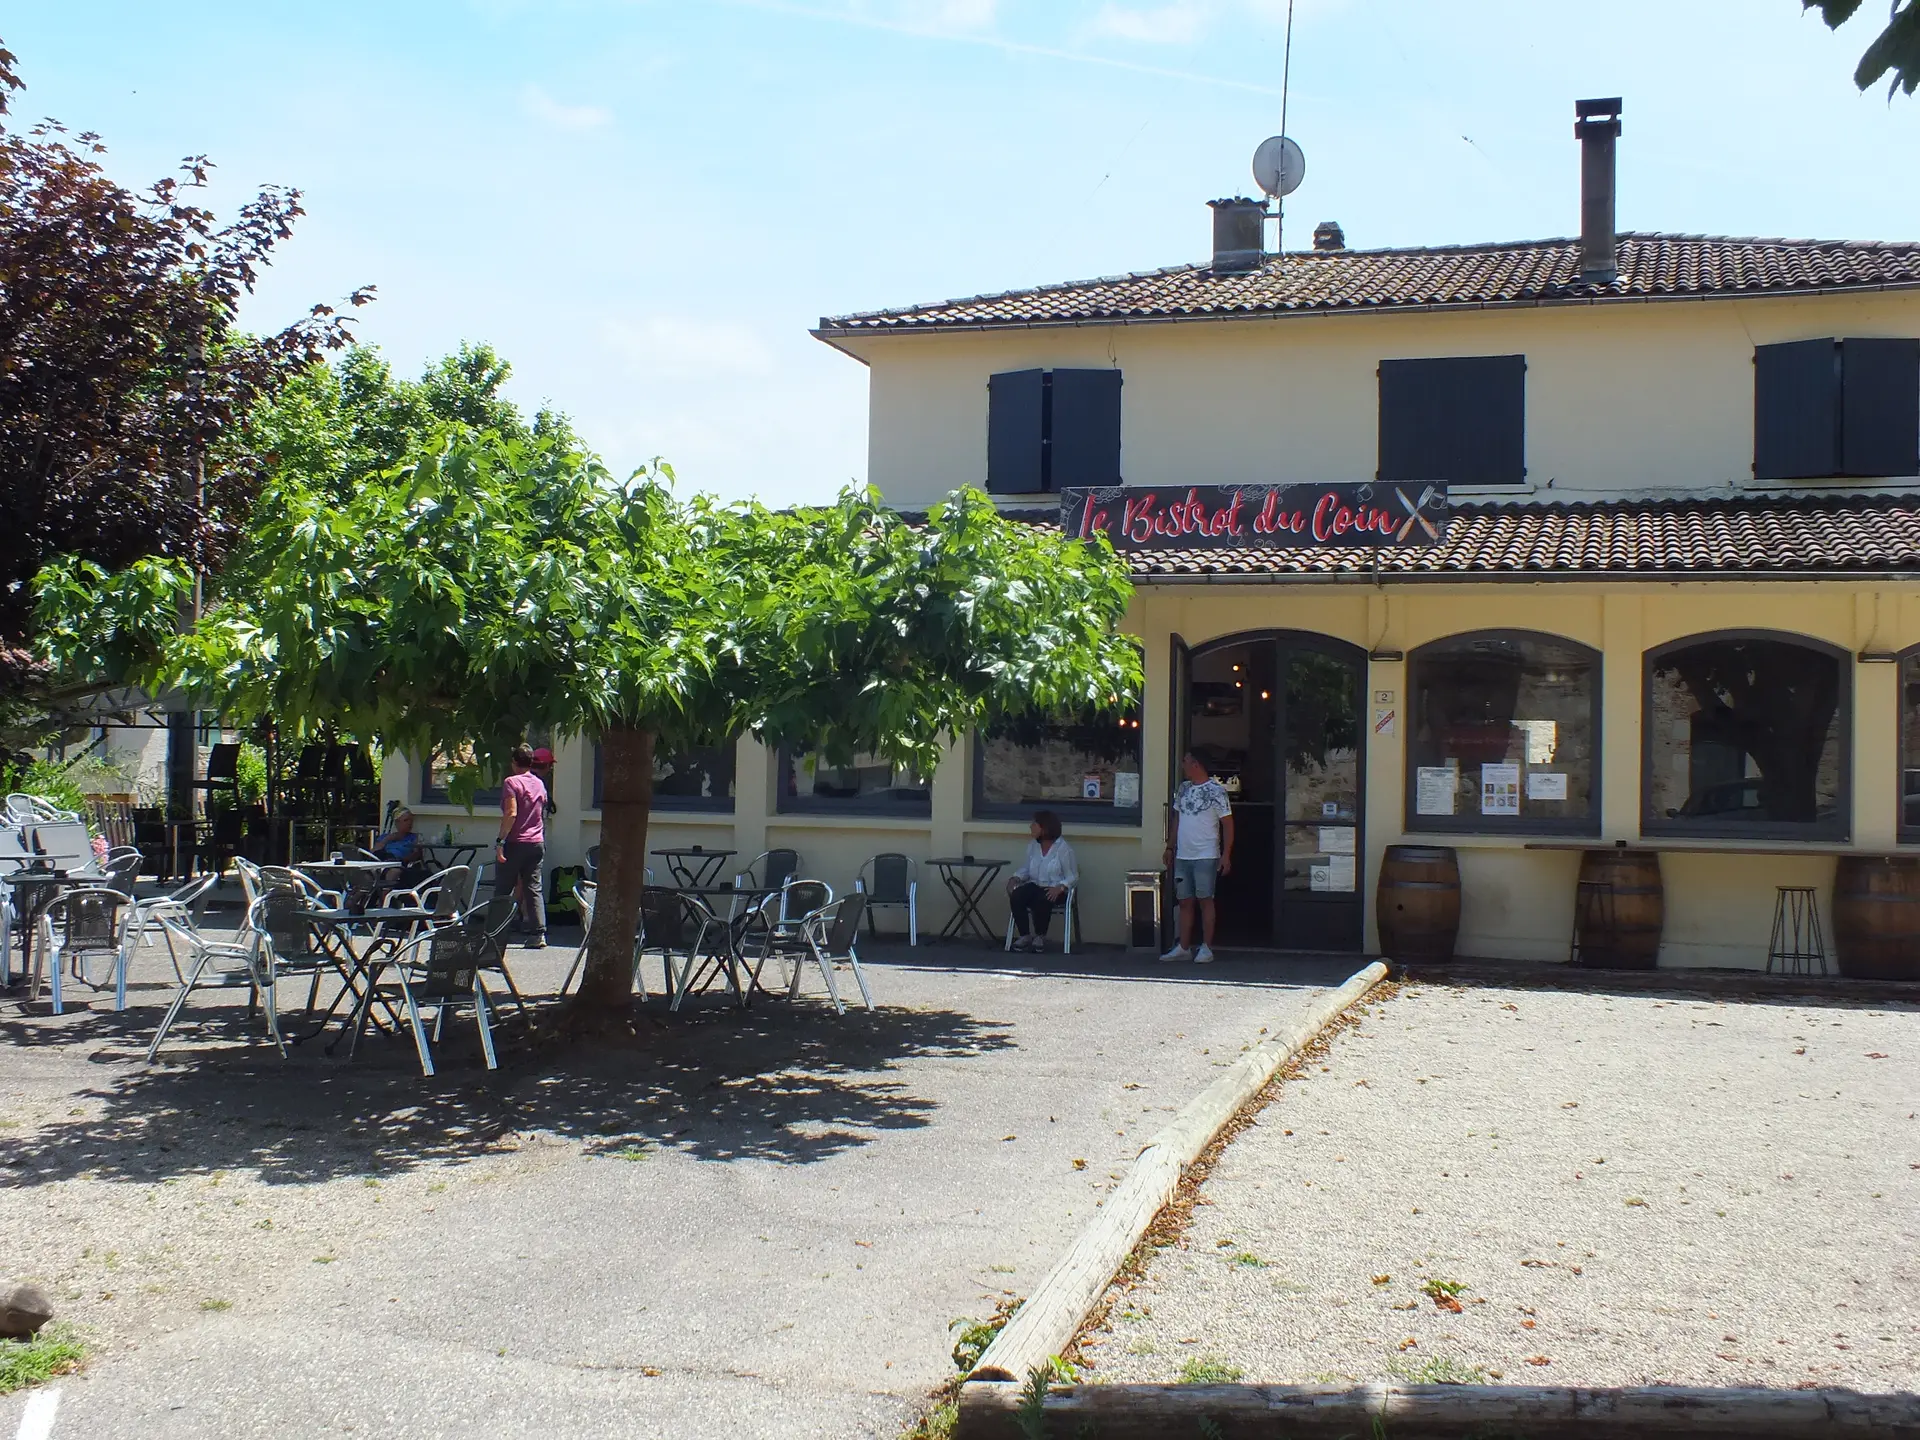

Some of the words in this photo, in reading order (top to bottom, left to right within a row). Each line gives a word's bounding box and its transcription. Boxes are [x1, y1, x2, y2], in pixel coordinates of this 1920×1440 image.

[1079, 494, 1113, 543] Le
[1122, 487, 1243, 543] Bistrot
[1253, 490, 1305, 534] du
[1312, 492, 1400, 542] Coin
